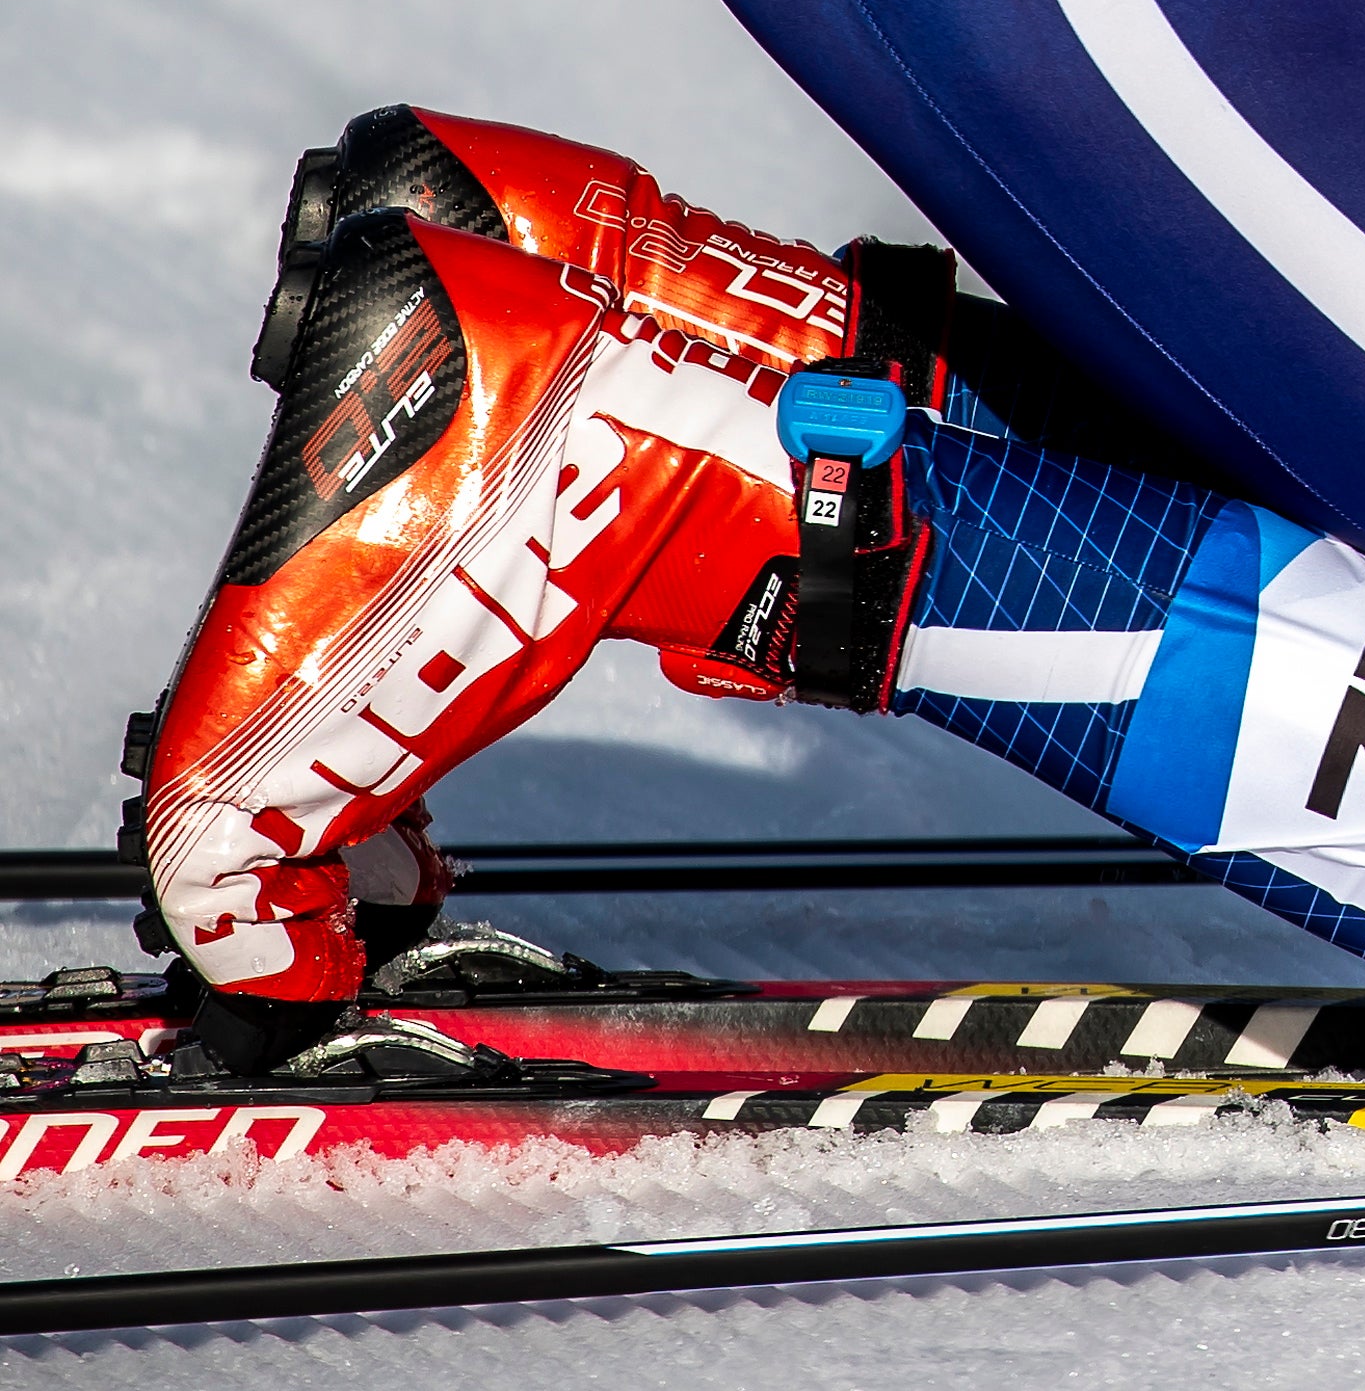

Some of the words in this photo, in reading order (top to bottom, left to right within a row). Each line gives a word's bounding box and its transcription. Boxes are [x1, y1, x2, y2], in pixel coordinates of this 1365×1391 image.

[338, 371, 434, 493] ELITE
[822, 466, 848, 486] 22
[811, 498, 839, 521] 22
